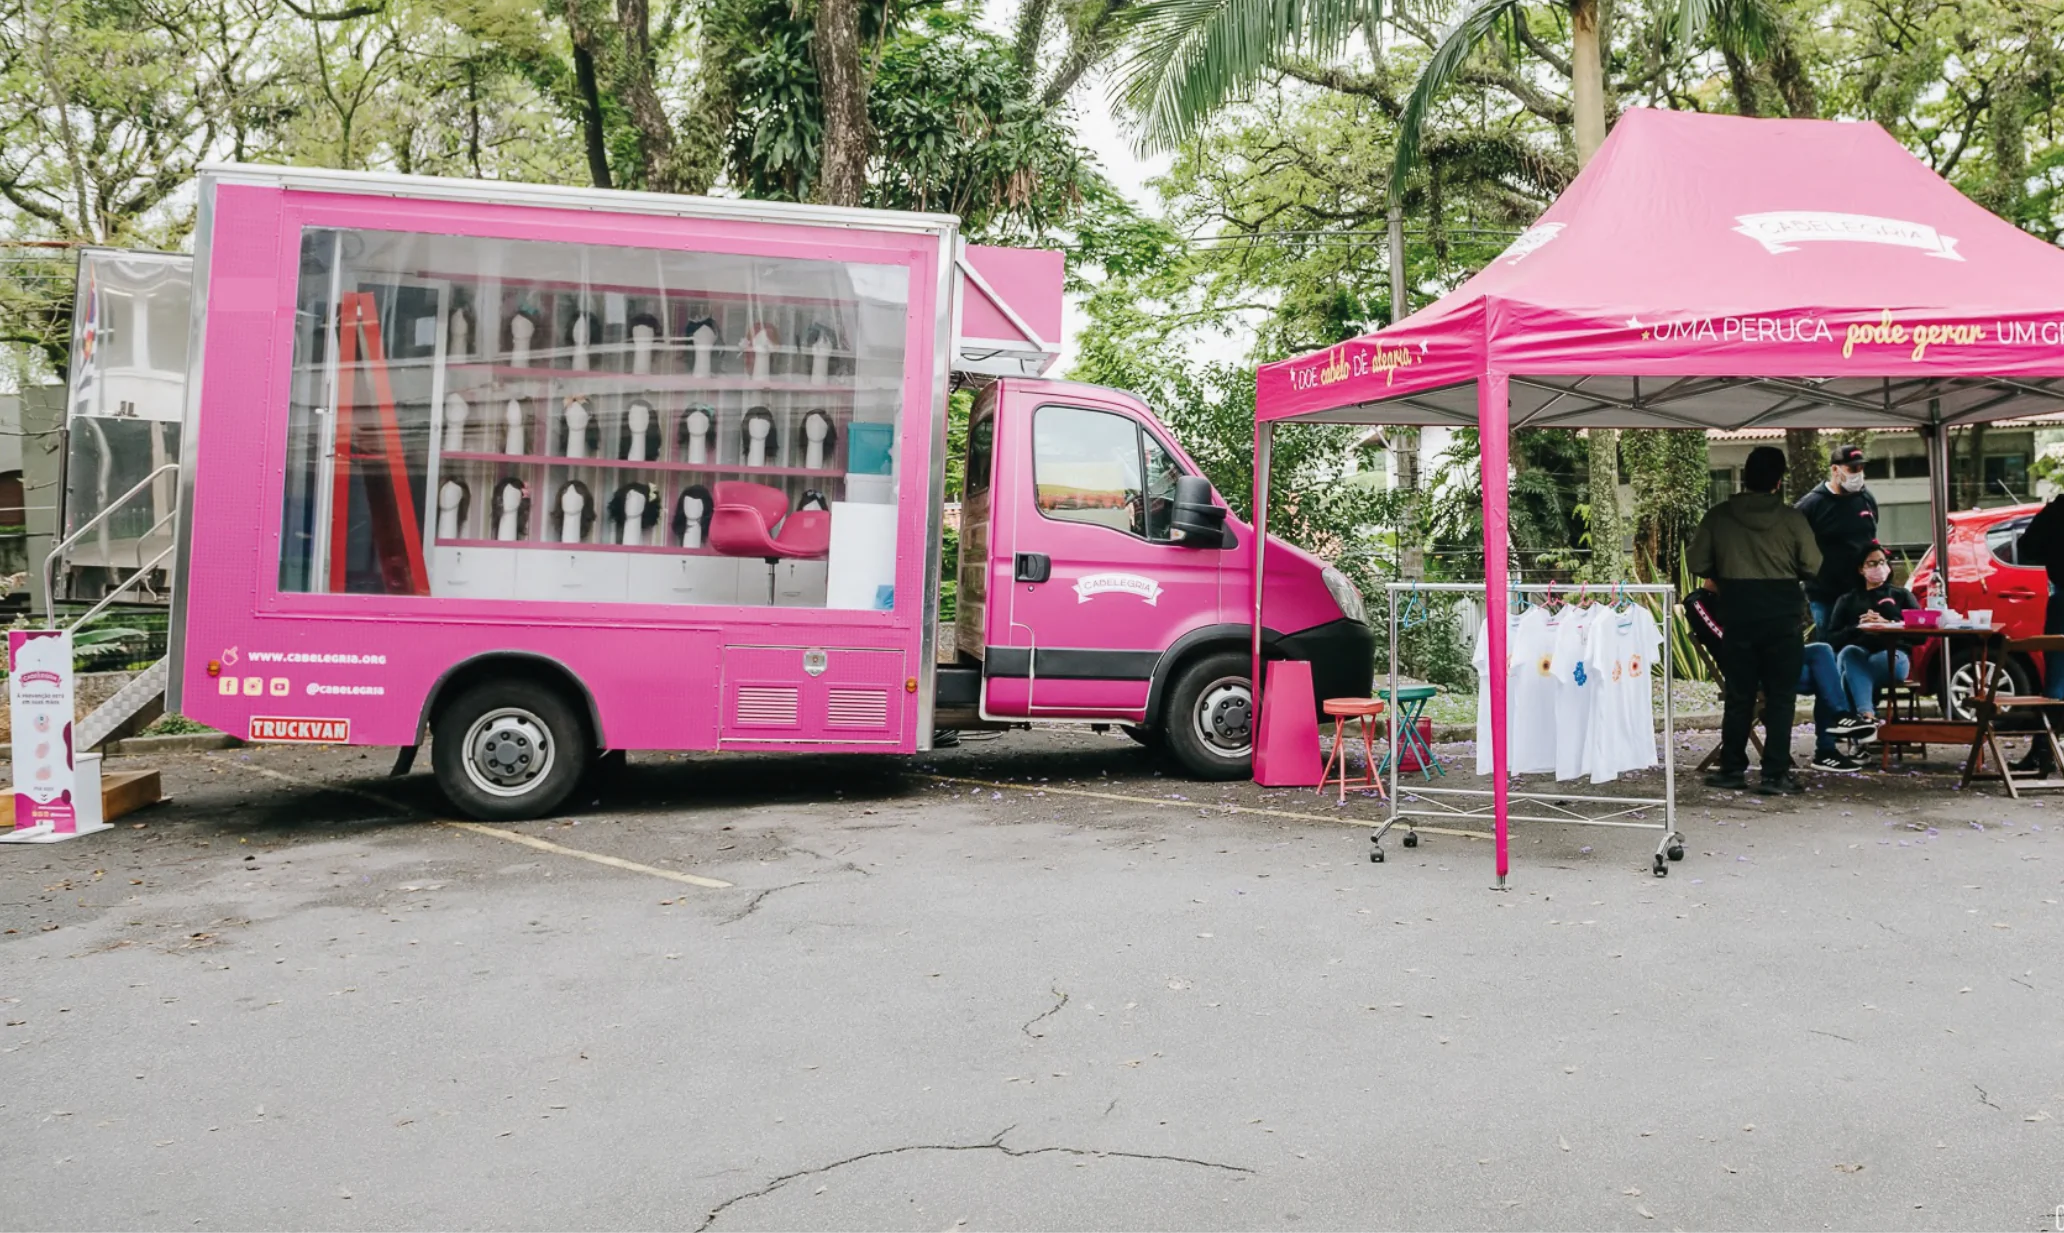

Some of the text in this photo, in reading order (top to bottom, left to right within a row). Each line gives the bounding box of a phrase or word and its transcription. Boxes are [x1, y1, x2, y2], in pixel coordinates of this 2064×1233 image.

[1653, 317, 1718, 341] UMA
[1722, 317, 1834, 343] PERUCA
[1842, 308, 1909, 358] pode
[1911, 324, 1986, 362] gerar
[1996, 321, 2036, 345] UM
[1298, 339, 1413, 390] DOE cabelo DÊ alegria
[1083, 578, 1151, 593] CABELEGRIA
[252, 721, 347, 740] TRUCKVAN
